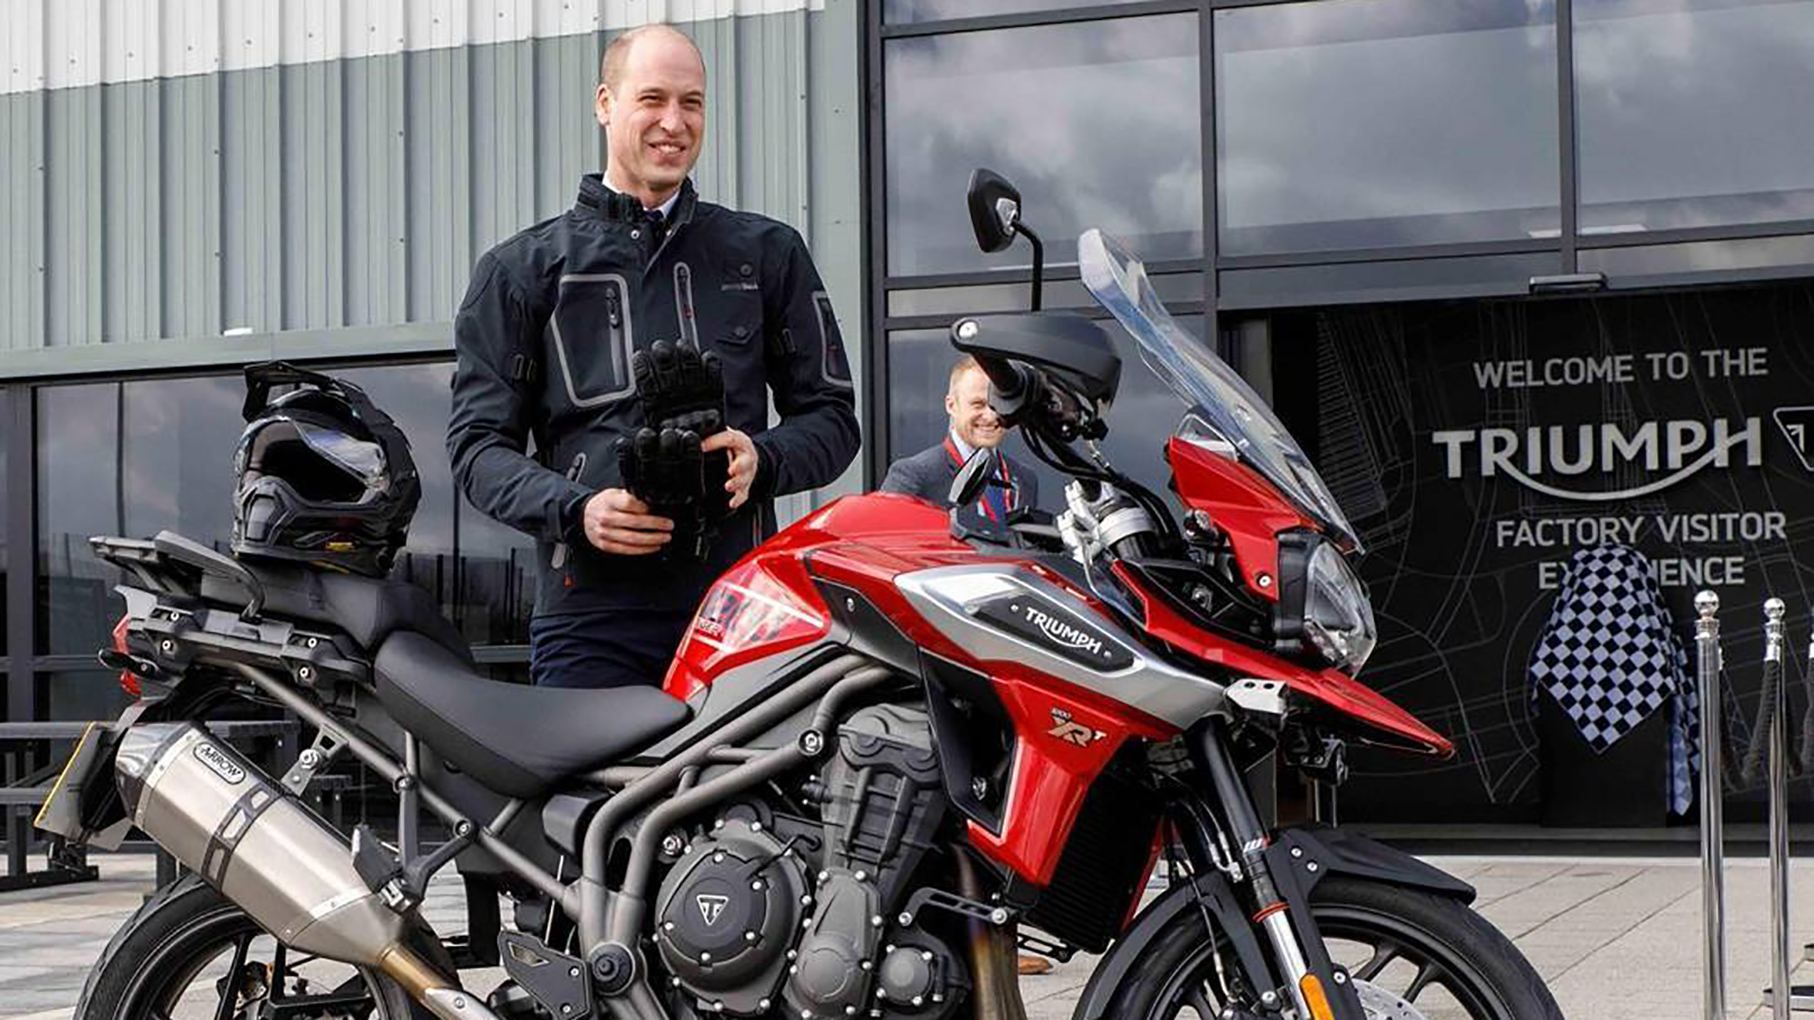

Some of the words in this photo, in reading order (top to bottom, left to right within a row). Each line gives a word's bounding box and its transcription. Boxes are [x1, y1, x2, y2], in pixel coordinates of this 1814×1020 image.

[1473, 355, 1634, 389] WELCOME
[1646, 352, 1689, 381] TO
[1700, 347, 1768, 376] THE
[1432, 417, 1762, 500] TRIUMPH
[1496, 516, 1645, 548] FACTORY
[1657, 512, 1787, 544] VISITOR
[1024, 606, 1101, 655] TRIUMPH
[200, 747, 241, 776] ARROW
